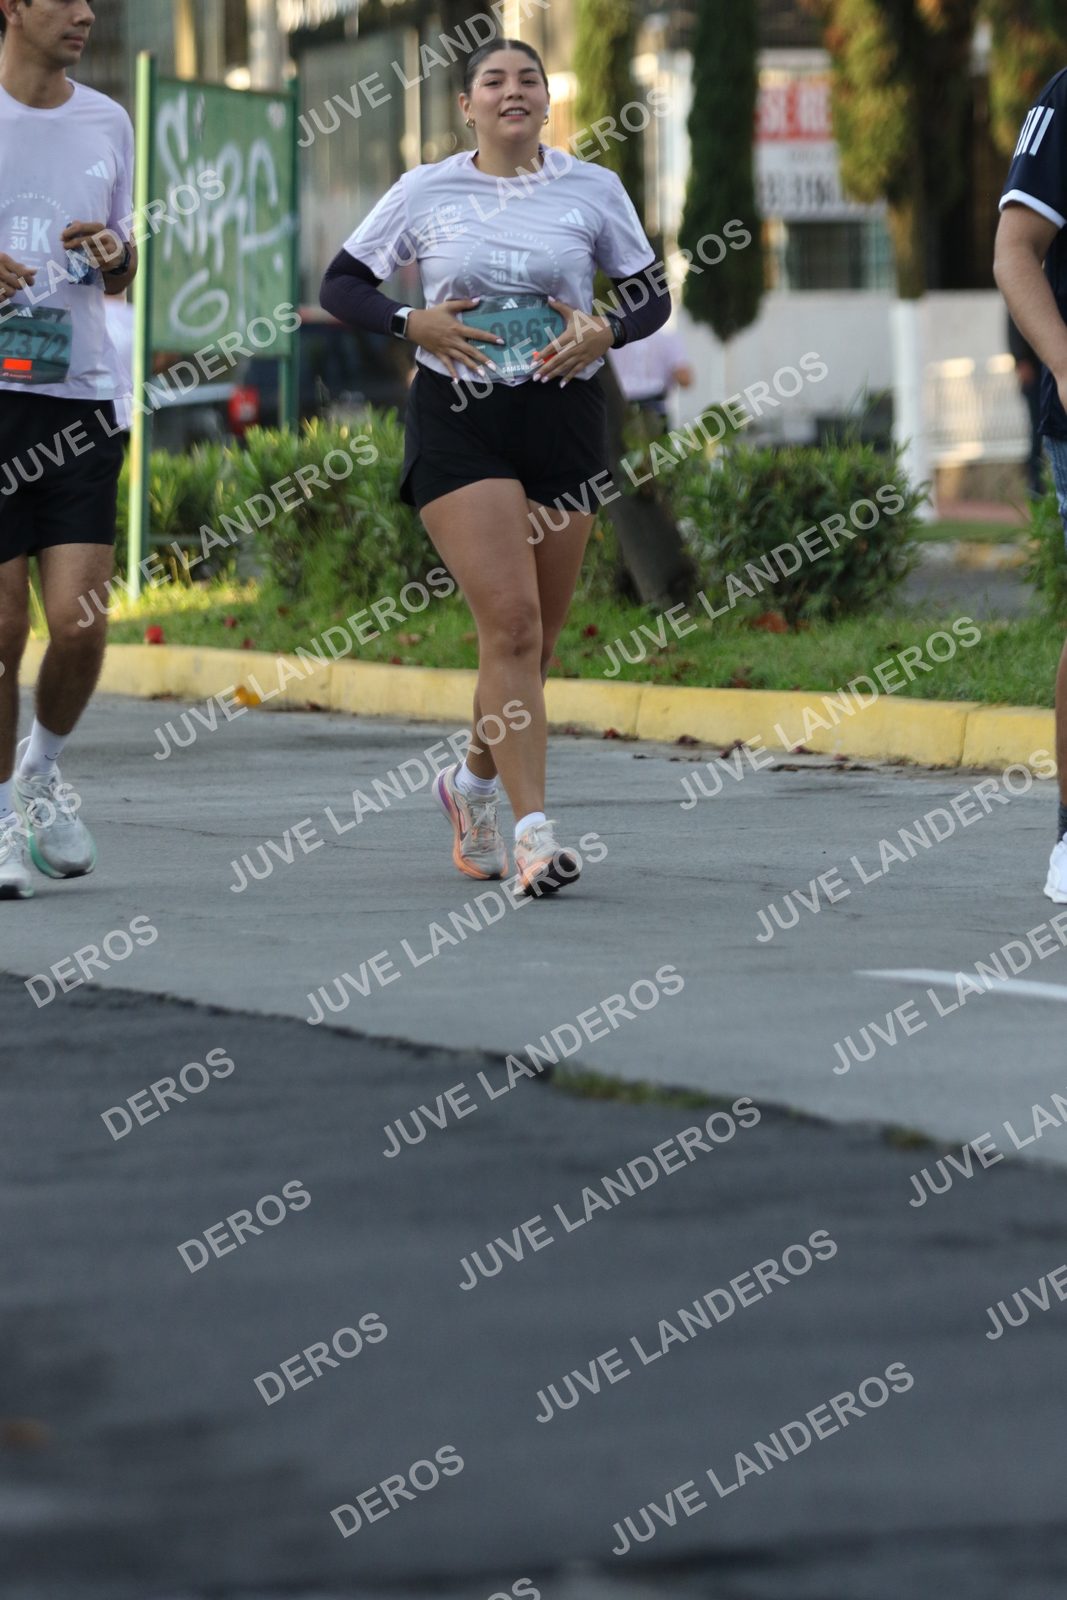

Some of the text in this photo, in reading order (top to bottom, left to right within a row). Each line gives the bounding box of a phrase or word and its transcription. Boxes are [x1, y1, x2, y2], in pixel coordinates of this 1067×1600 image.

[12, 216, 28, 230] 15
[31, 218, 52, 253] K
[10, 236, 27, 251] 30
[489, 250, 507, 265] 15
[510, 251, 531, 283] K
[490, 270, 507, 283] 30
[502, 365, 535, 374] SAMSUN
